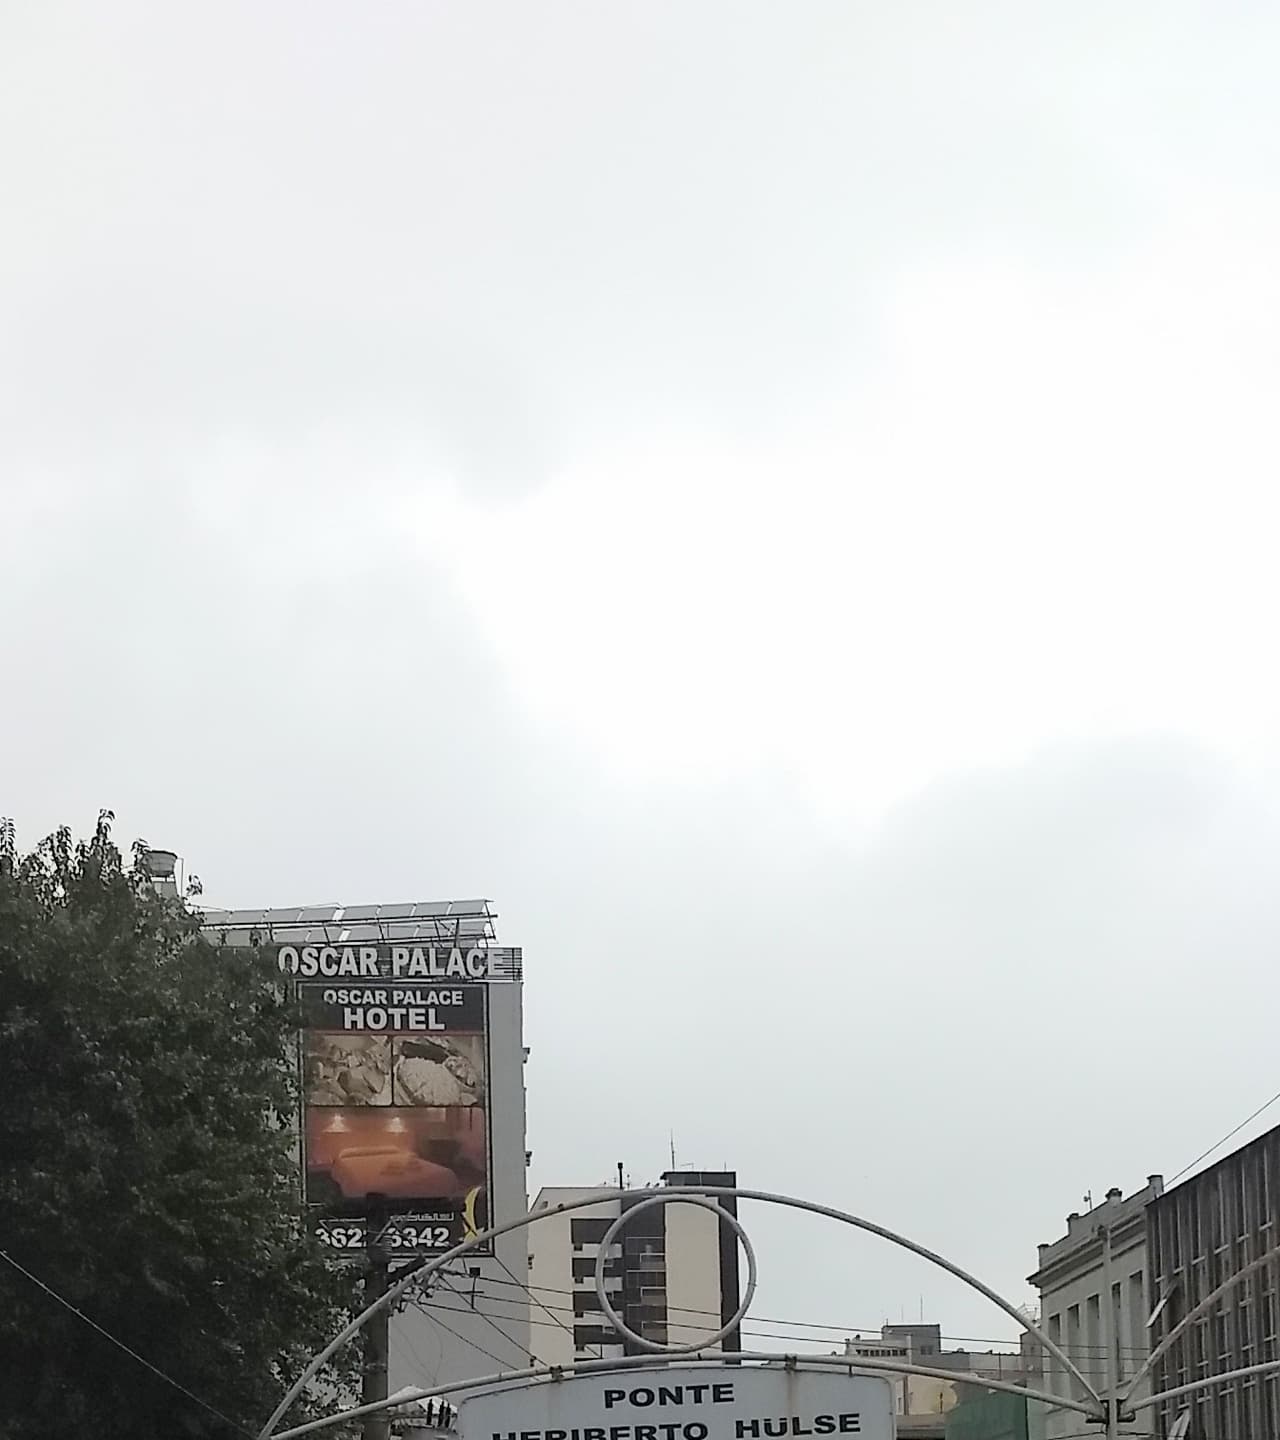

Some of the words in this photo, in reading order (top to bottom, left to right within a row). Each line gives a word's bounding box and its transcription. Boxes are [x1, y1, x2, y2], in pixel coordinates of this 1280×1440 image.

[278, 946, 380, 977] OSCAR
[392, 946, 505, 977] PALACE
[323, 989, 388, 1005] OSCAR
[393, 990, 464, 1006] PALACE
[343, 1007, 447, 1031] HOTEL
[603, 1383, 736, 1409] PONTE
[734, 1413, 862, 1439] HÜLSE
